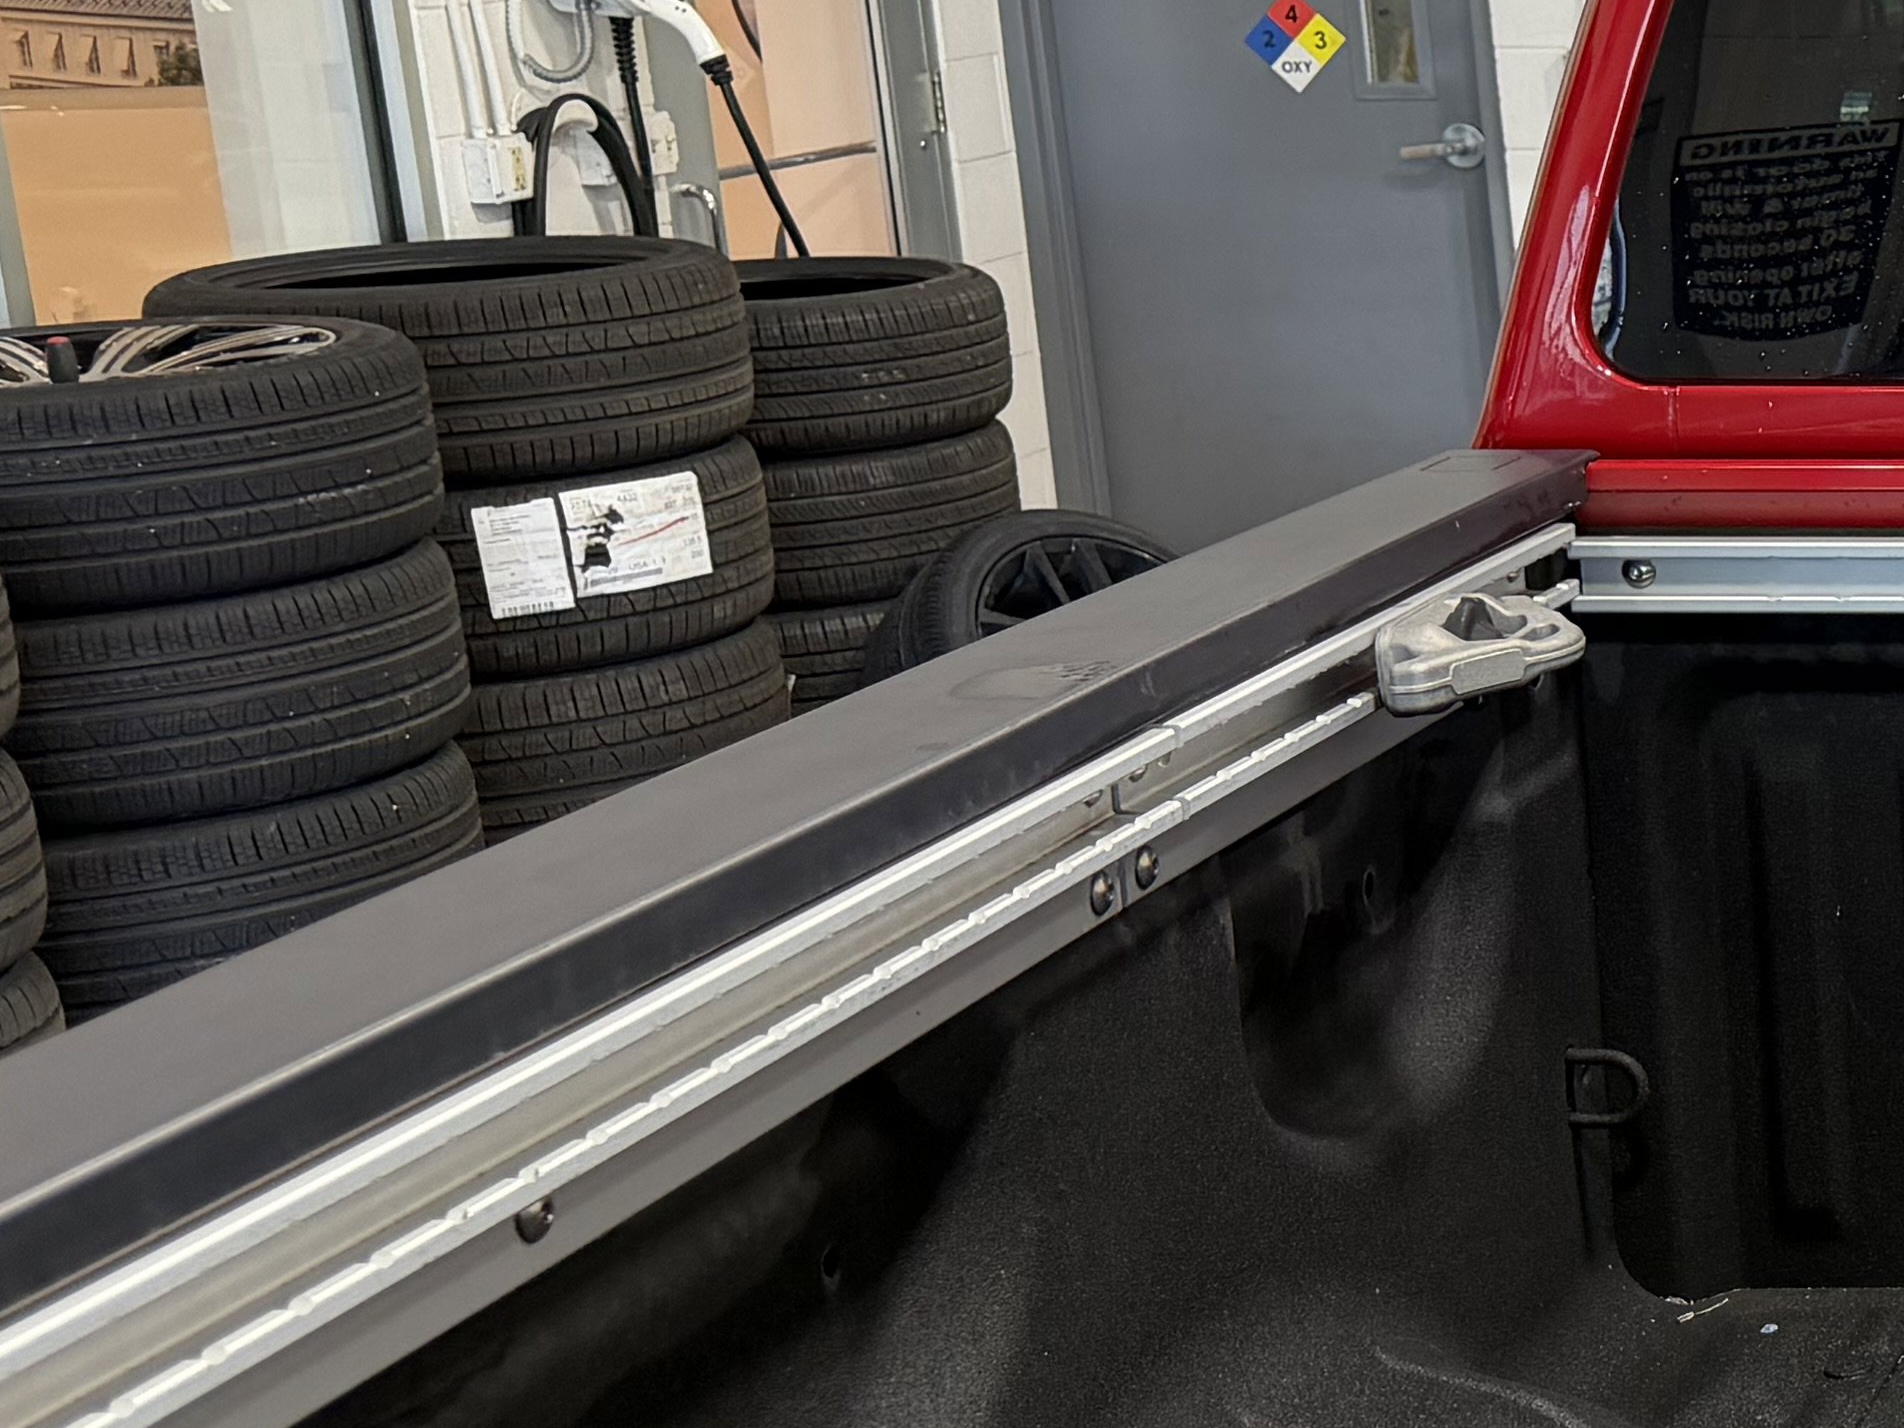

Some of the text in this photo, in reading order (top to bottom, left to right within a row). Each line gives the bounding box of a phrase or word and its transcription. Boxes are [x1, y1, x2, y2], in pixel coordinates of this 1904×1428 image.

[1284, 4, 1298, 24] 4
[1263, 30, 1277, 49] 2
[1314, 30, 1328, 50] 3
[1281, 60, 1313, 74] OXY
